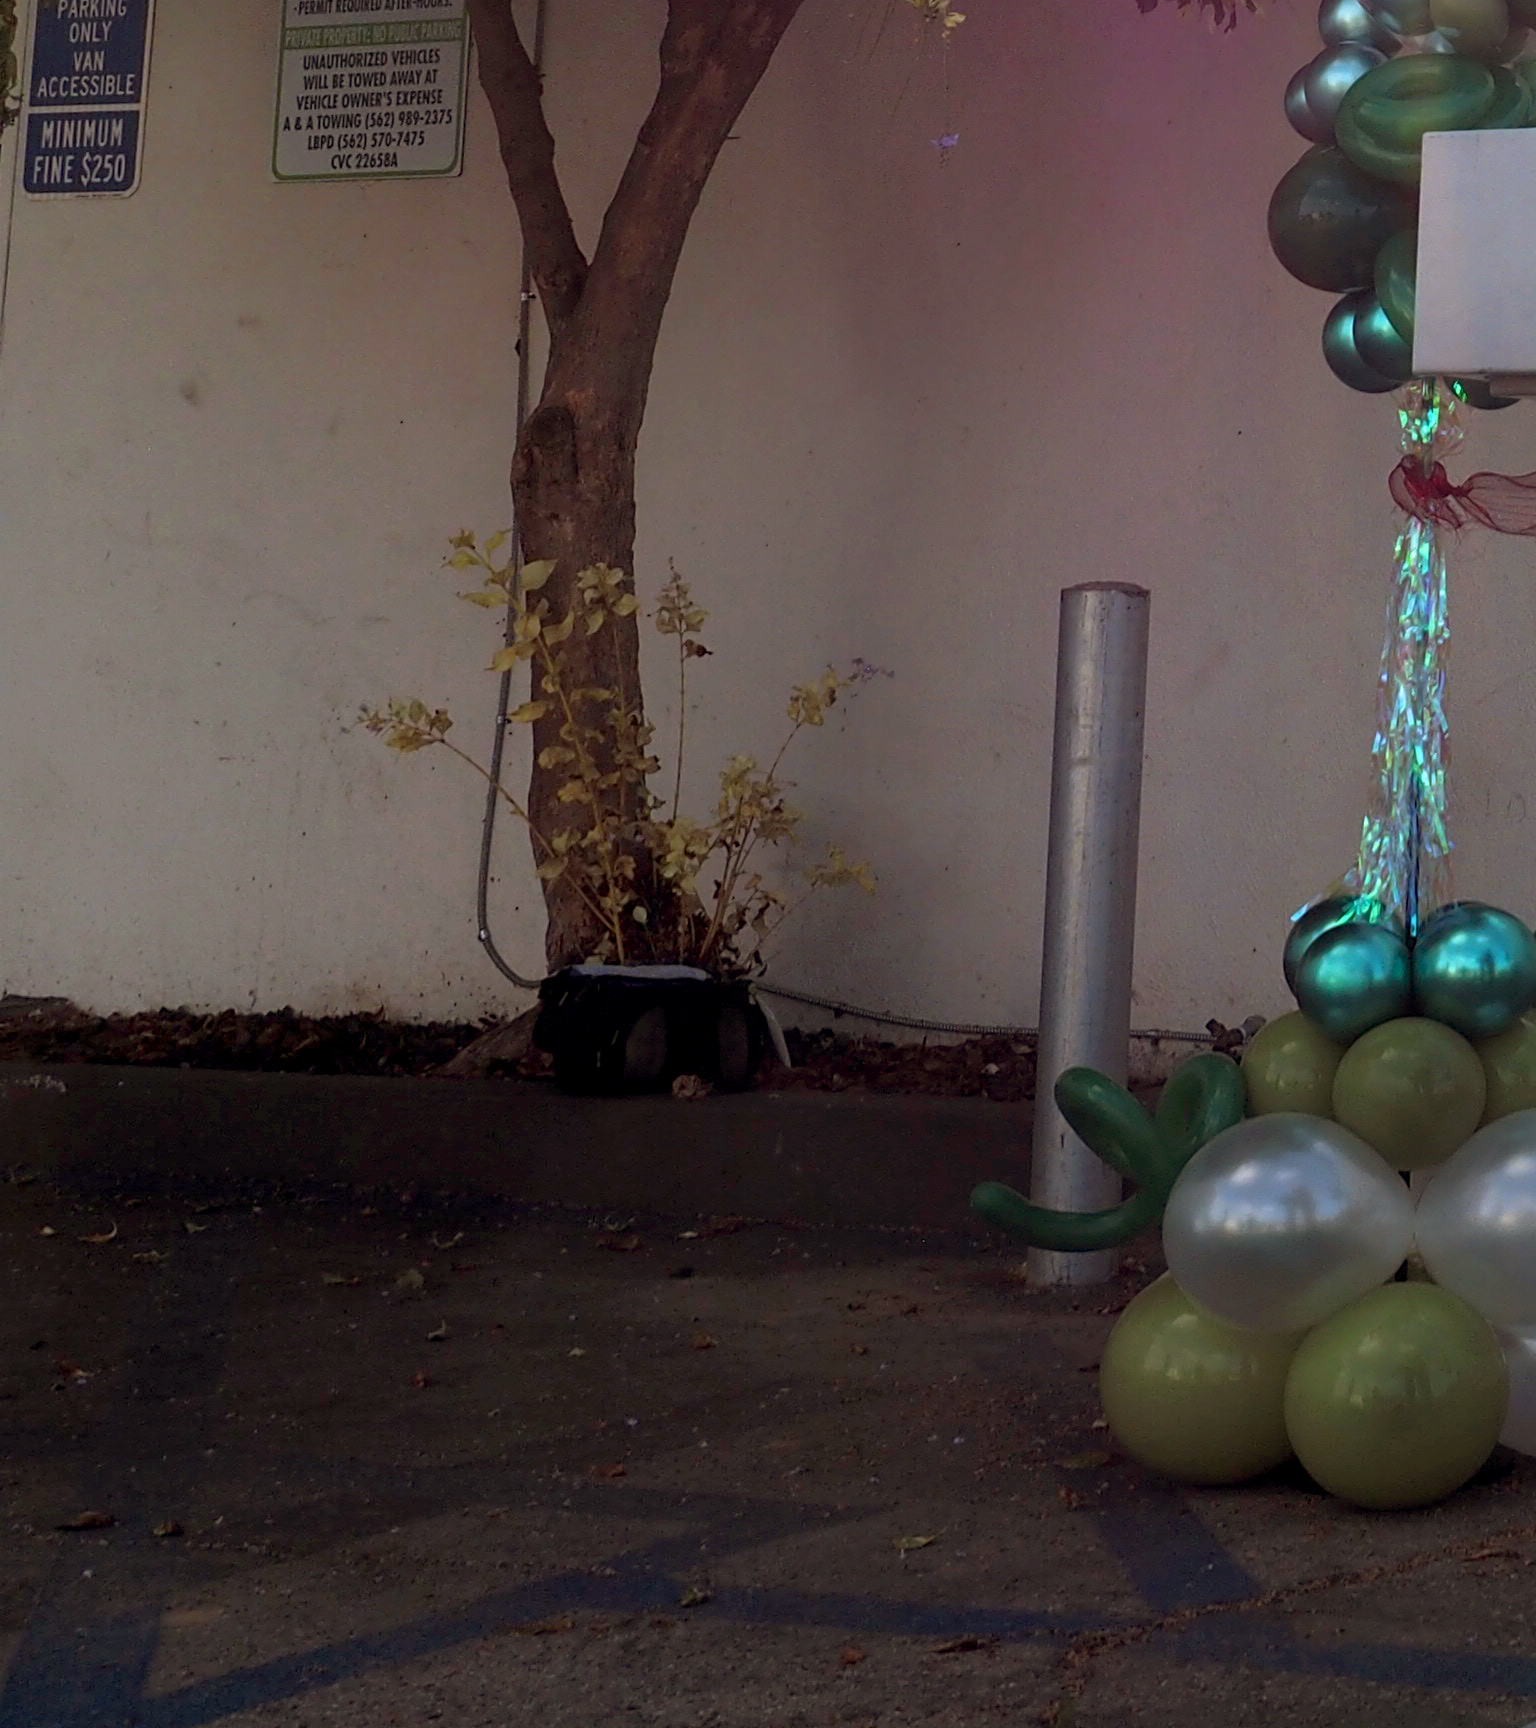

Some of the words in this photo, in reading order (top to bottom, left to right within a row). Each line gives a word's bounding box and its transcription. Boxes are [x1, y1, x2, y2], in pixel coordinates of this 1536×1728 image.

[69, 20, 112, 43] ONLY
[73, 51, 105, 72] VAN
[303, 50, 388, 70] UNAUTHORIZED
[392, 48, 440, 65] VEHICLES
[37, 74, 136, 98] ACCESSIBLE
[303, 74, 329, 90] WILL
[332, 73, 345, 89] BE
[348, 71, 387, 88] TOWED
[389, 70, 421, 86] AWAY
[424, 68, 438, 84] AT
[297, 93, 338, 110] VEHICLE
[342, 91, 393, 108] OWNER'S
[396, 89, 443, 106] EXPENSE
[283, 117, 291, 131] A
[294, 116, 302, 131] &
[305, 115, 314, 130] A
[316, 113, 362, 130] TOWING
[365, 111, 395, 130] (562)
[399, 109, 453, 126] 989-2375
[41, 118, 123, 148] MINIMUM
[307, 134, 334, 150] LBPD
[337, 132, 367, 150] (562)
[371, 130, 425, 148] 570-7475
[33, 154, 75, 184] FINE
[81, 152, 126, 188] $250
[331, 154, 352, 170] CVC
[355, 152, 398, 169] 22658A
